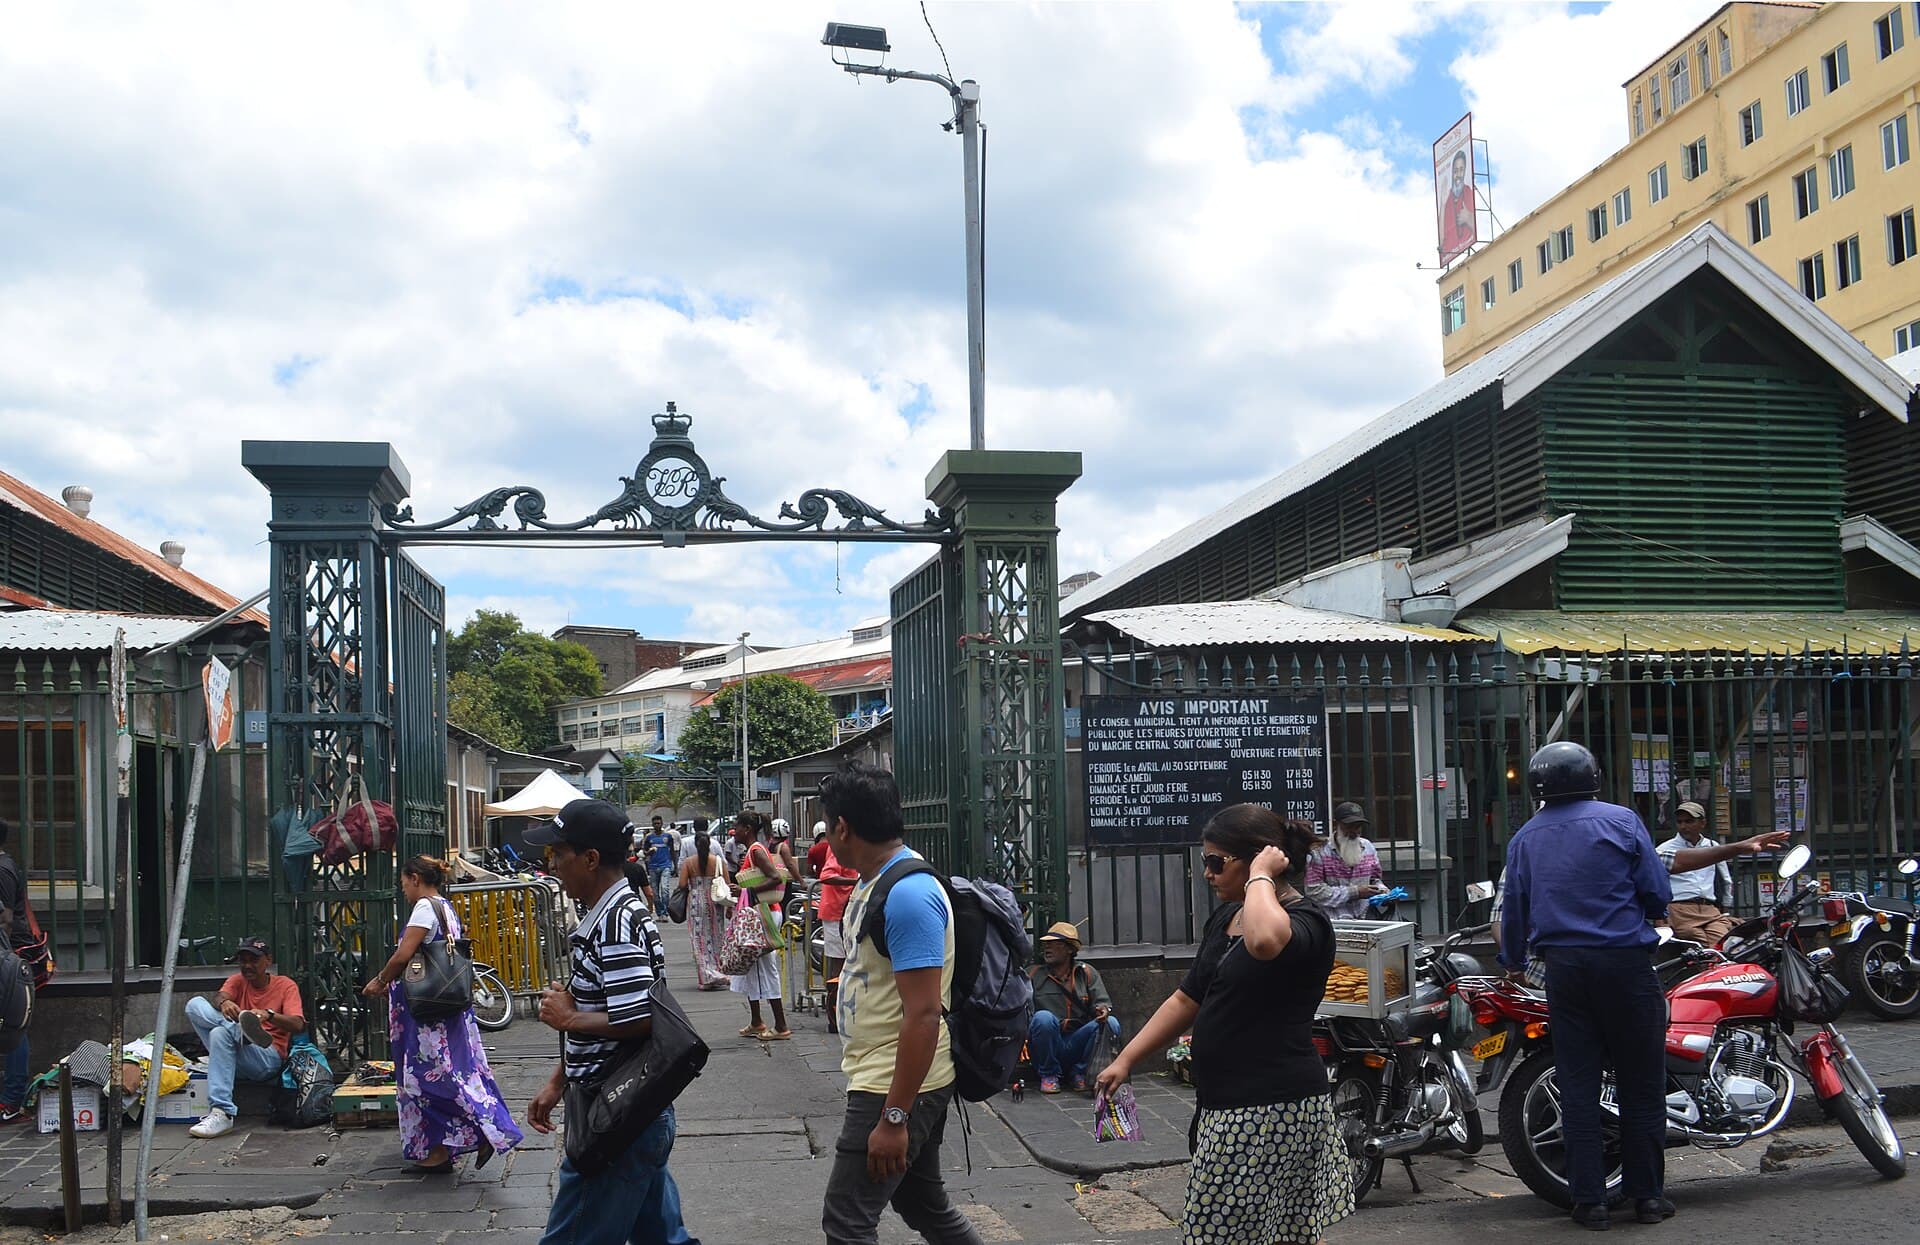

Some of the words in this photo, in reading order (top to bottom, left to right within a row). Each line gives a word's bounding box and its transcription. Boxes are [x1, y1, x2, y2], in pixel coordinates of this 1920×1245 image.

[1140, 701, 1174, 715] AVIS
[1184, 700, 1269, 714] IMPORTANT
[1088, 718, 1097, 727] LE
[1100, 718, 1131, 727] CONSEIL
[1134, 717, 1176, 727] MUNICIPAL
[1178, 716, 1203, 726] TIENT
[1204, 716, 1210, 725] A
[1212, 716, 1250, 725] INFORMER
[1252, 716, 1267, 725] LES
[1269, 715, 1304, 724] MEMBRES
[1307, 715, 1318, 724] DU
[1088, 730, 1116, 739] PUBLIC
[1118, 729, 1134, 740] QUE
[1137, 729, 1153, 738] LES
[1155, 728, 1186, 738] HEURES
[1188, 727, 1239, 737] D'OUVERTURE
[1242, 727, 1251, 736] ET
[1254, 727, 1264, 736] DE
[1266, 726, 1311, 736] FERMETURE
[1088, 741, 1099, 751] DU
[1102, 741, 1132, 751] MARCHE
[1135, 740, 1170, 750] CENTRAL
[1174, 739, 1193, 749] SONT
[1196, 739, 1222, 748] COMME
[1224, 739, 1242, 748] SUIT
[1230, 748, 1275, 758] OUVERTURE
[1278, 747, 1323, 757] FERMETURE
[1089, 763, 1122, 773] PERIODE
[1138, 762, 1160, 772] AVRIL
[1161, 762, 1171, 772] AU
[1172, 761, 1183, 771] 30
[1184, 760, 1228, 770] SEPTEMBRE
[1090, 774, 1112, 783] LUNDI
[1114, 774, 1121, 783] A
[1123, 773, 1152, 782] SAMEDI
[1090, 785, 1127, 794] DIMANCHE
[1131, 784, 1140, 794] ET
[1144, 784, 1164, 793] JOUR
[1167, 783, 1189, 792] FERIE
[1090, 796, 1122, 804] PERIODE
[1140, 794, 1175, 803] OCTOBRE
[1178, 794, 1189, 803] AU
[1191, 793, 1200, 802] 31
[1202, 792, 1222, 802] MARS
[1090, 807, 1113, 816] LUNDI
[1115, 807, 1121, 815] A
[1123, 806, 1151, 815] SAMEDI
[1091, 818, 1127, 827] DIMANCHE
[1131, 817, 1140, 826] ET
[1144, 816, 1164, 826] JOUR
[1167, 816, 1189, 825] FERIE
